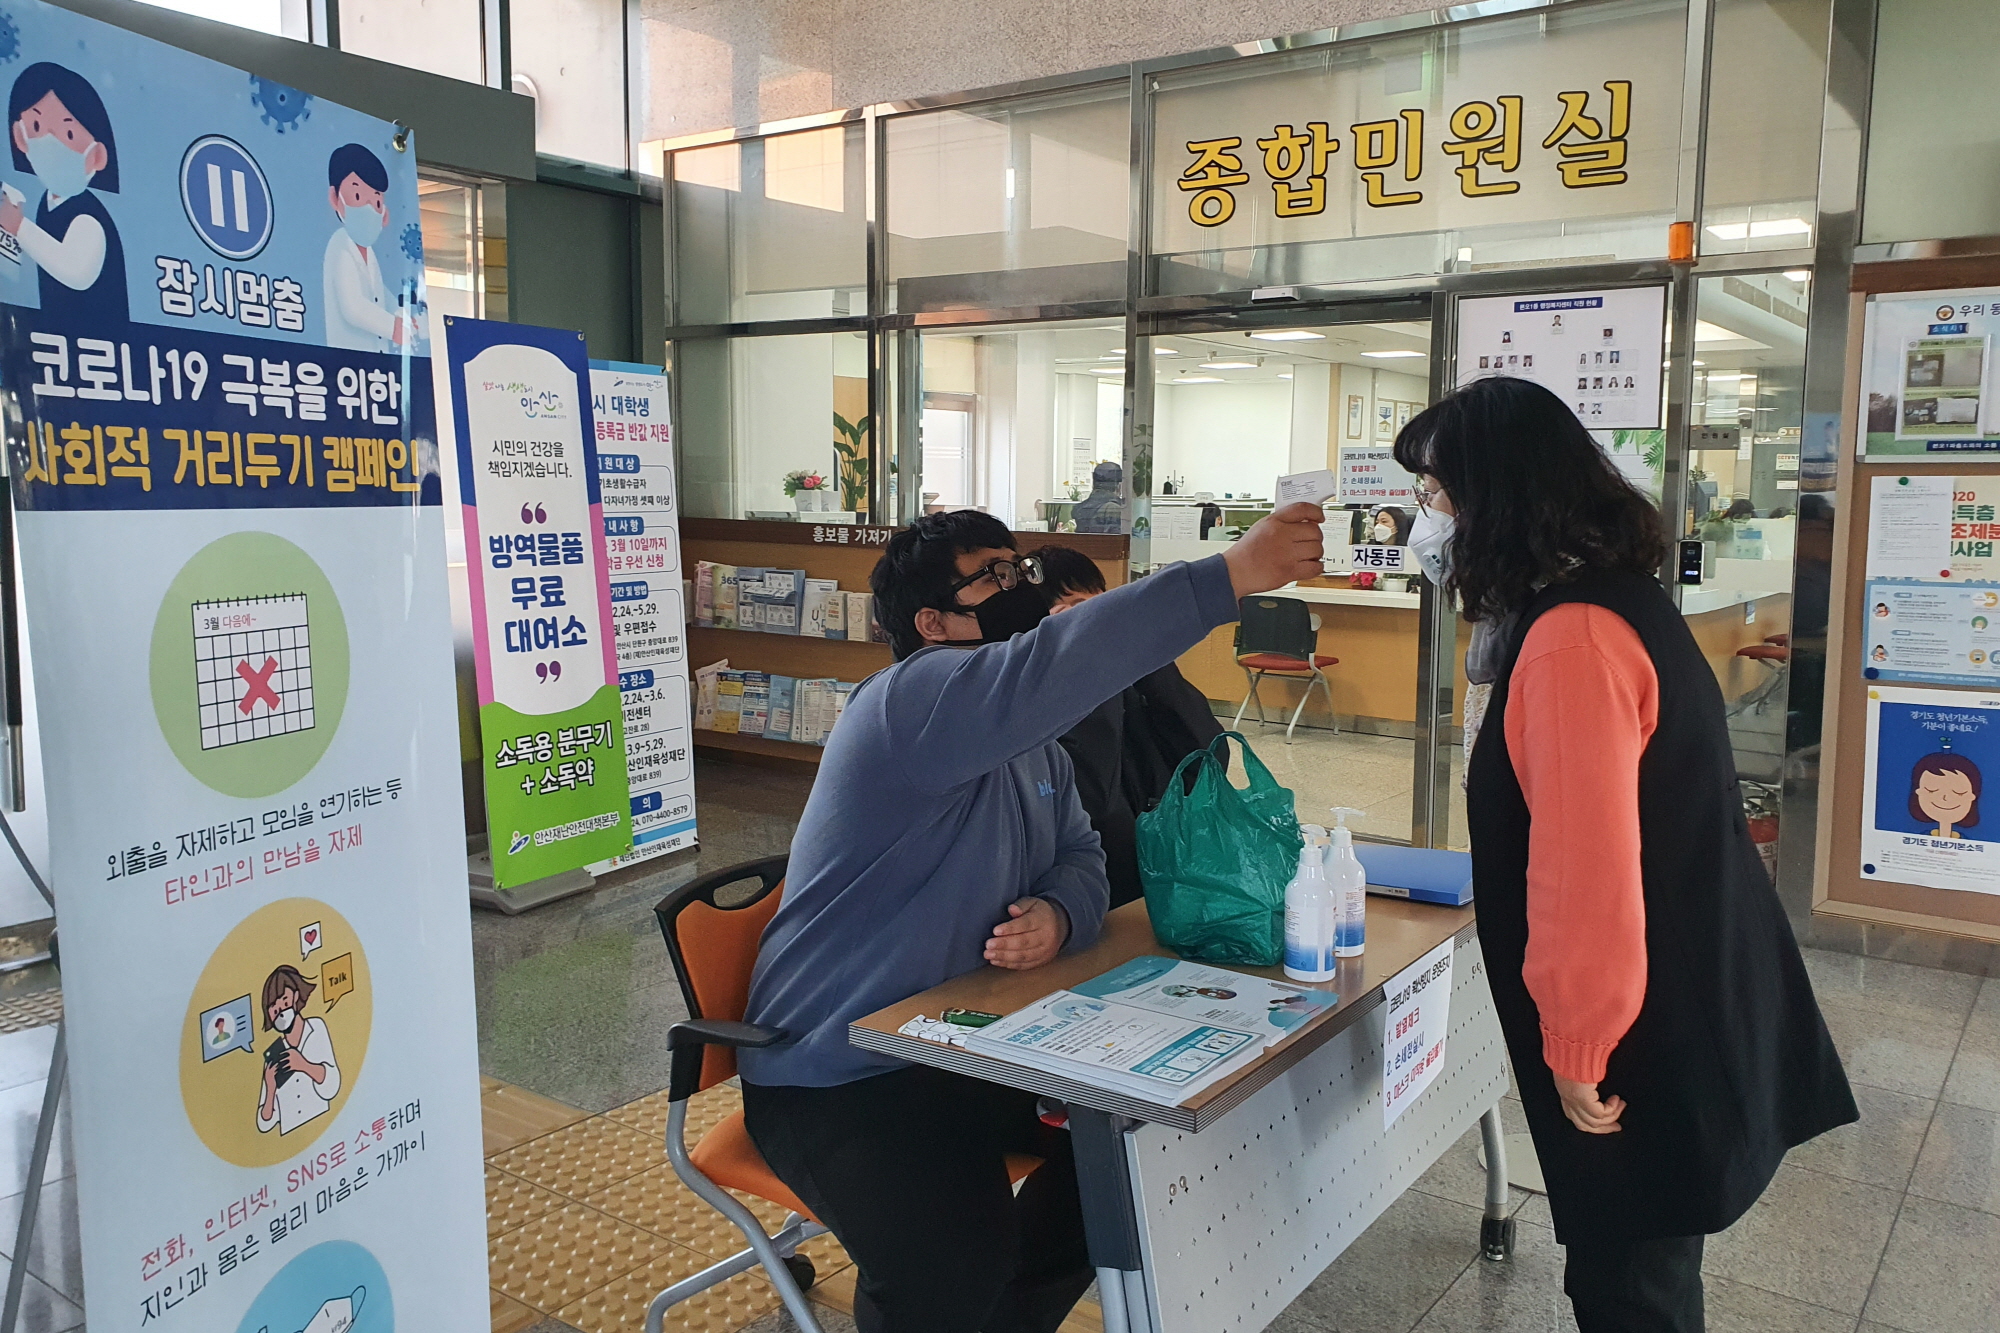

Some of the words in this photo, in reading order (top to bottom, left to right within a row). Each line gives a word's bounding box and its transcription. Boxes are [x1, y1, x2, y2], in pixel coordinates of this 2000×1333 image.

[1177, 80, 1632, 227] 종합민원실
[156, 255, 306, 332] 잠시멈춤
[1960, 304, 1985, 317] 우리
[30, 331, 208, 406] 코로나19
[221, 353, 328, 421] 극복을
[336, 365, 402, 425] 위한
[611, 396, 650, 417] 대학생
[596, 421, 626, 441] 등록금
[628, 422, 648, 442] 반값
[650, 423, 670, 443] 지원
[22, 420, 153, 492] 사회적
[163, 428, 314, 488] 거리두기
[322, 435, 420, 492] 캠페인
[492, 440, 527, 458] 시민의
[530, 440, 564, 459] 건강을
[487, 461, 572, 479] 책임지겠습니다.
[597, 457, 635, 471] 원대상
[604, 496, 638, 507] 다자녀가정
[656, 495, 670, 507] 이상
[610, 538, 626, 552] 3월
[629, 537, 668, 552] 10일까지
[813, 525, 849, 544] 홍보물
[489, 531, 584, 569] 방역물품
[1354, 547, 1401, 567] 자동문
[625, 556, 643, 570] 우선
[645, 553, 664, 569] 신청
[511, 575, 567, 611] 무료
[633, 582, 647, 596] 방법
[203, 617, 221, 631] 3월
[504, 613, 588, 654] 대여소
[624, 621, 657, 636] 우편접수
[629, 671, 647, 685] 장소
[1910, 711, 1935, 720] 경기도
[496, 731, 554, 769] 소독용
[557, 719, 614, 758] 분무기
[539, 757, 596, 795] 소독약
[106, 840, 168, 881] 외출을
[176, 817, 256, 860] 자제하고
[262, 802, 314, 837] 모임을
[320, 786, 383, 820] 연기하는
[385, 777, 403, 800] 등
[534, 811, 620, 847] 안산재난안전대책본부
[1902, 836, 1929, 847] 경기도
[1930, 840, 1985, 853] 청년기본소득
[164, 855, 255, 906] 타인과의
[263, 837, 321, 876] 만남을
[327, 822, 363, 855] 자제
[328, 971, 347, 988] Talk
[1396, 1007, 1419, 1039] 발열체크
[1395, 1031, 1425, 1070] 손세정실시
[1394, 1073, 1409, 1100] 마스크
[141, 1234, 195, 1281] 전화,
[205, 1184, 278, 1242] 인터넷,
[286, 1142, 347, 1194] SNS로
[354, 1098, 422, 1156] 소통하며
[140, 1262, 209, 1327] 지인과
[218, 1234, 260, 1276] 몸은
[269, 1201, 308, 1244] 멀리
[316, 1166, 370, 1215] 마음은
[377, 1130, 427, 1177] 가까이
